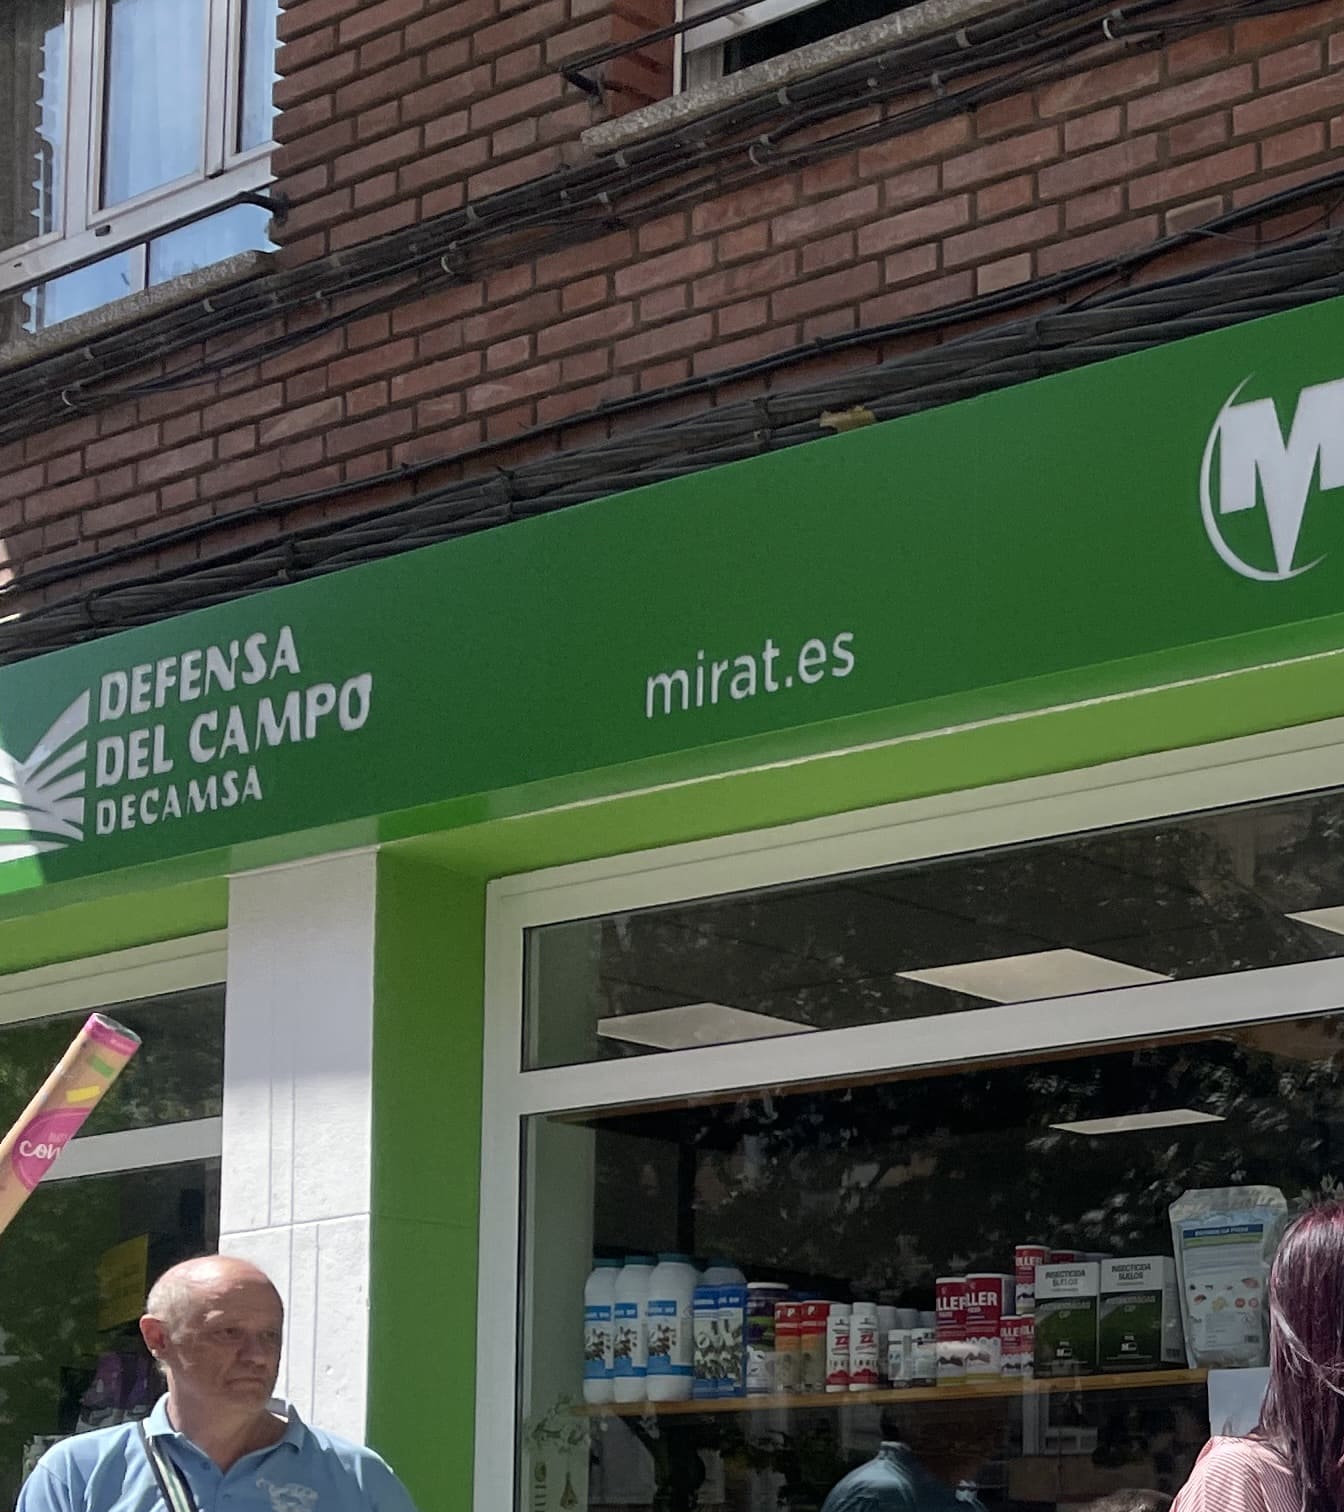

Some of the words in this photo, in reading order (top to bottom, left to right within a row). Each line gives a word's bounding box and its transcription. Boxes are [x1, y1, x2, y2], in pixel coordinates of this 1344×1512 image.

[98, 625, 302, 723] DEFENSA
[644, 630, 856, 718] mirat.es
[95, 724, 175, 788] DEL
[189, 673, 373, 766] CAMPO
[95, 765, 264, 836] DECAMSA
